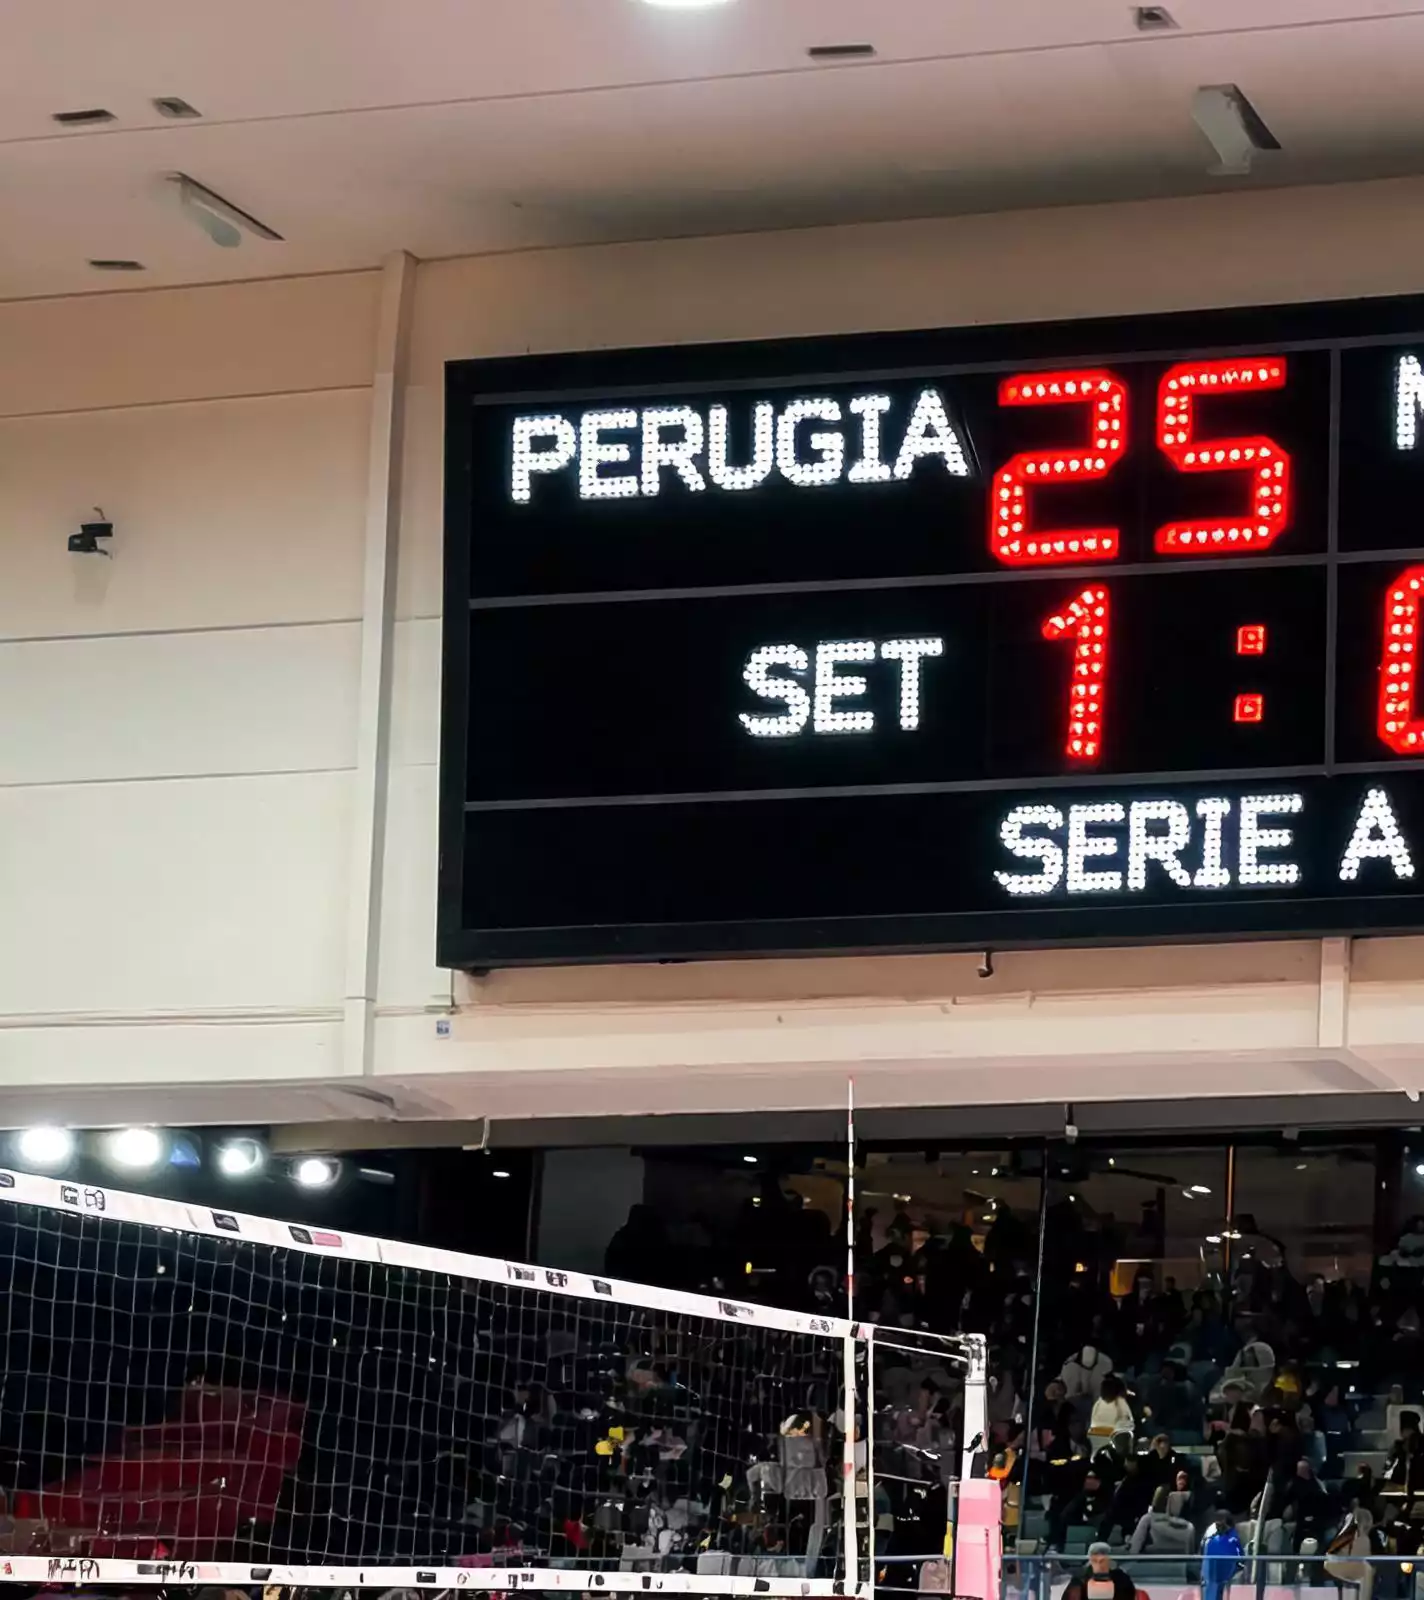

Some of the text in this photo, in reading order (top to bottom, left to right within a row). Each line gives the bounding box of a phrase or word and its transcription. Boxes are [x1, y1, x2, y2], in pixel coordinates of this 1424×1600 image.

[510, 358, 1292, 565] PERUGIA 25
[738, 636, 944, 738] SET
[1041, 583, 1110, 763] 1
[993, 788, 1416, 897] SERIE A
